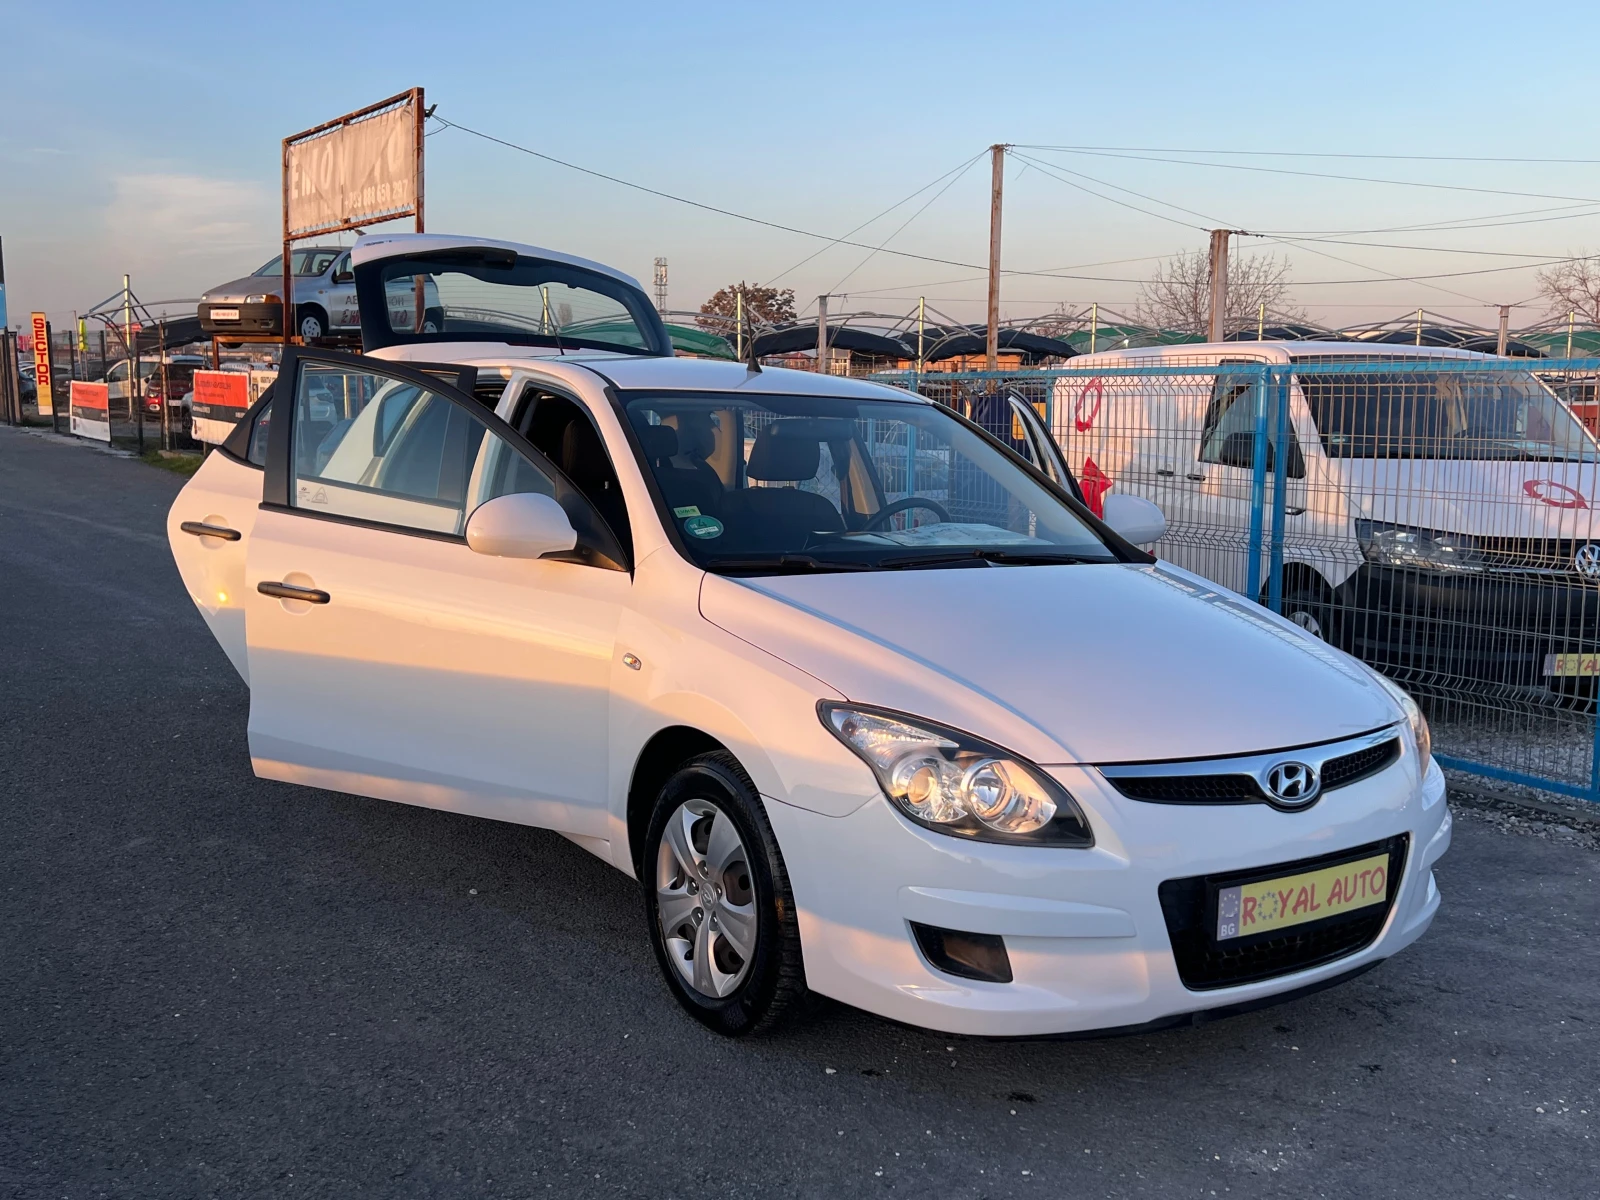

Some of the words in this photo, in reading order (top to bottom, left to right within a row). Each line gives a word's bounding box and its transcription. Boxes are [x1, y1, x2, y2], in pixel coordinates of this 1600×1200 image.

[33, 318, 49, 385] SECTOR
[1326, 866, 1386, 907] AUTO
[1220, 923, 1235, 937] BG
